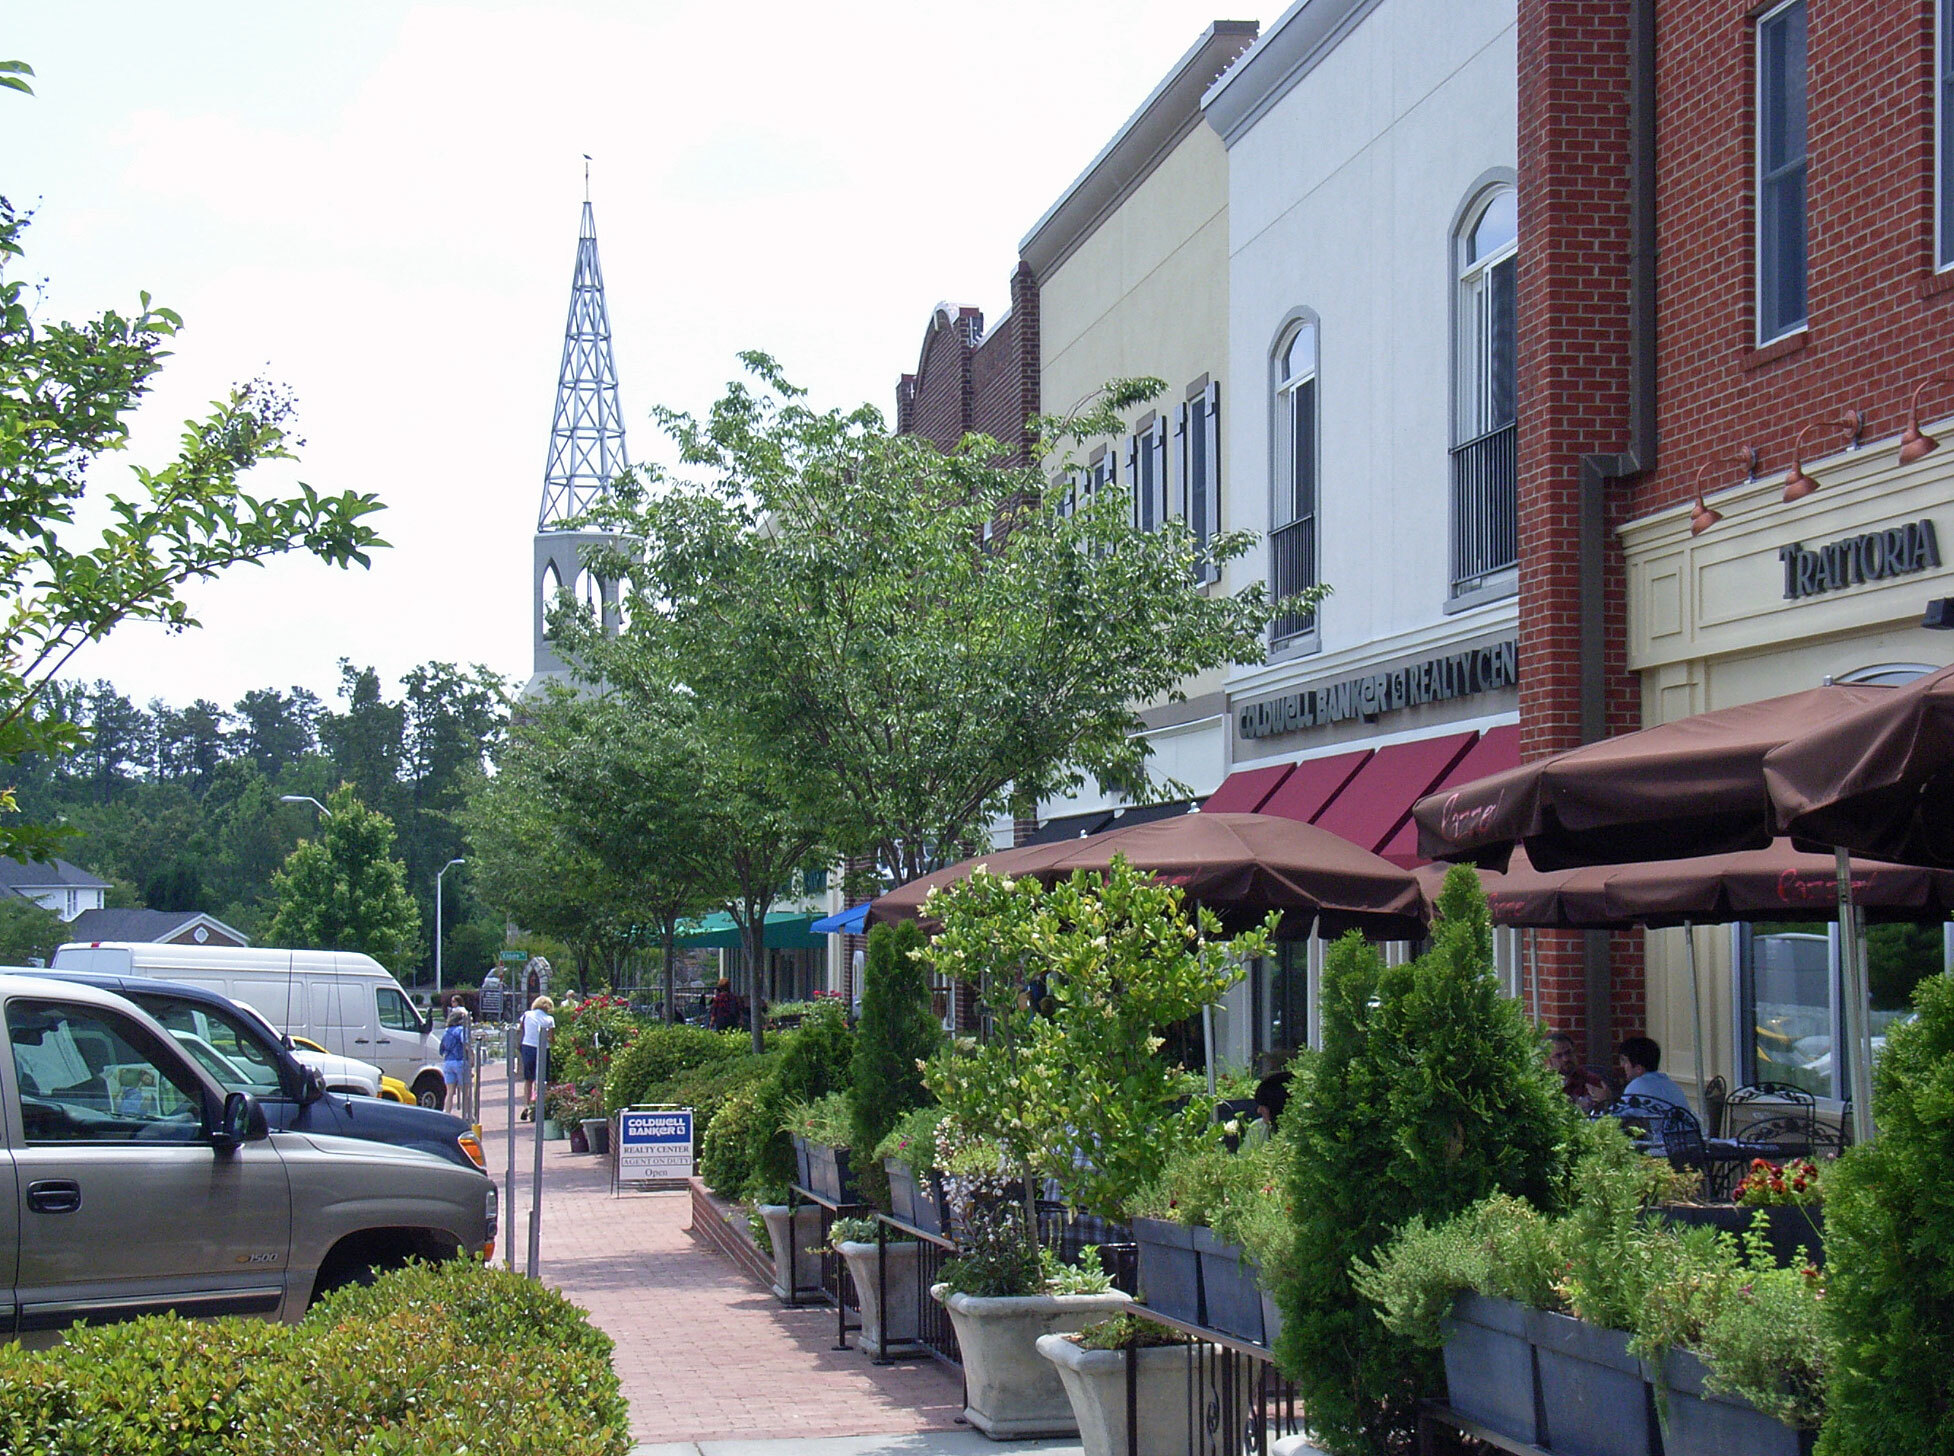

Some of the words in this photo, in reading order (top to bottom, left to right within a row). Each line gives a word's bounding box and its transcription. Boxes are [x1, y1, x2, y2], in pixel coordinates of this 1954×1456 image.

[1779, 519, 1942, 600] TRATTORIA
[1239, 690, 1316, 739] COLDWELL
[1315, 673, 1388, 723] BANKER
[1409, 650, 1474, 705] REALTY
[628, 1118, 686, 1127] COLDWELL
[628, 1126, 676, 1136] BANKER
[624, 1146, 656, 1154] REALTY
[656, 1145, 689, 1153] CENTER
[644, 1168, 668, 1178] Open
[250, 1253, 279, 1263] 1500
